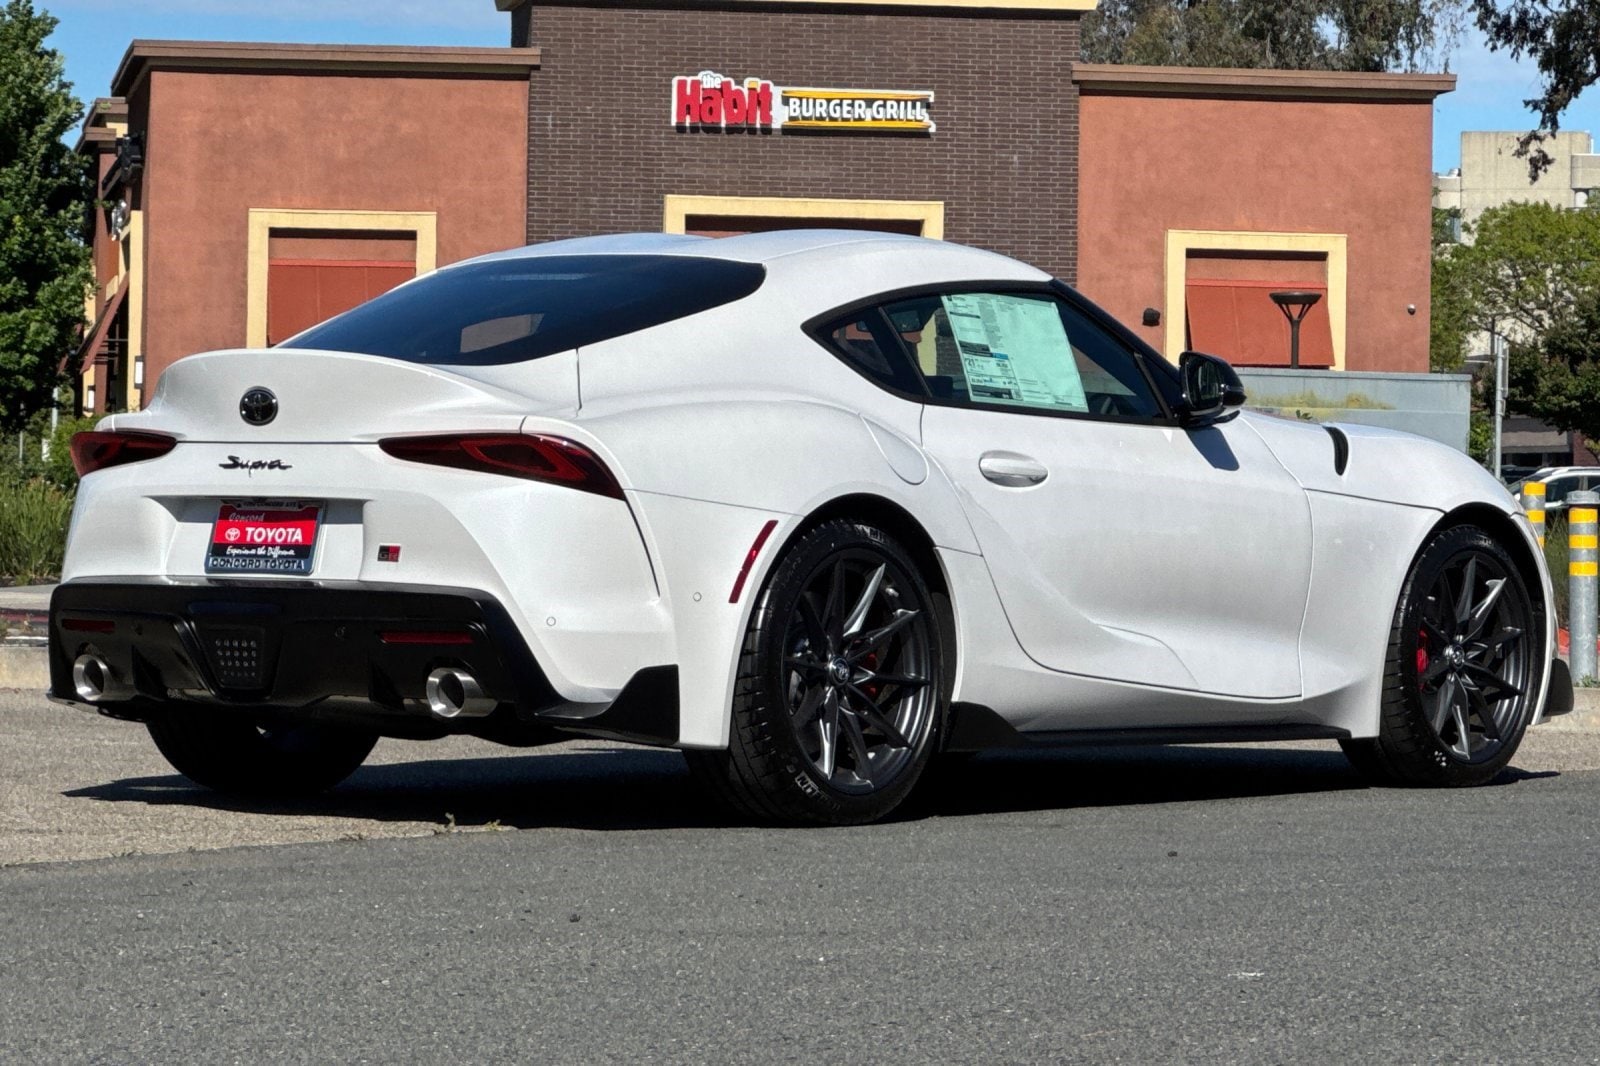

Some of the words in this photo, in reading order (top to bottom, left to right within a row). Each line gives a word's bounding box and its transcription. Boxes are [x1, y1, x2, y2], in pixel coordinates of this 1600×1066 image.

[702, 73, 722, 89] the
[676, 78, 773, 130] Habit
[788, 97, 867, 120] BURGER
[871, 100, 926, 121] GRILL
[218, 455, 293, 478] Supra
[228, 512, 265, 522] Concord
[245, 526, 303, 543] TOYOTA
[226, 545, 256, 556] Experience
[257, 545, 267, 555] the
[211, 558, 261, 569] CONCORD
[264, 560, 304, 570] TOYOTA
